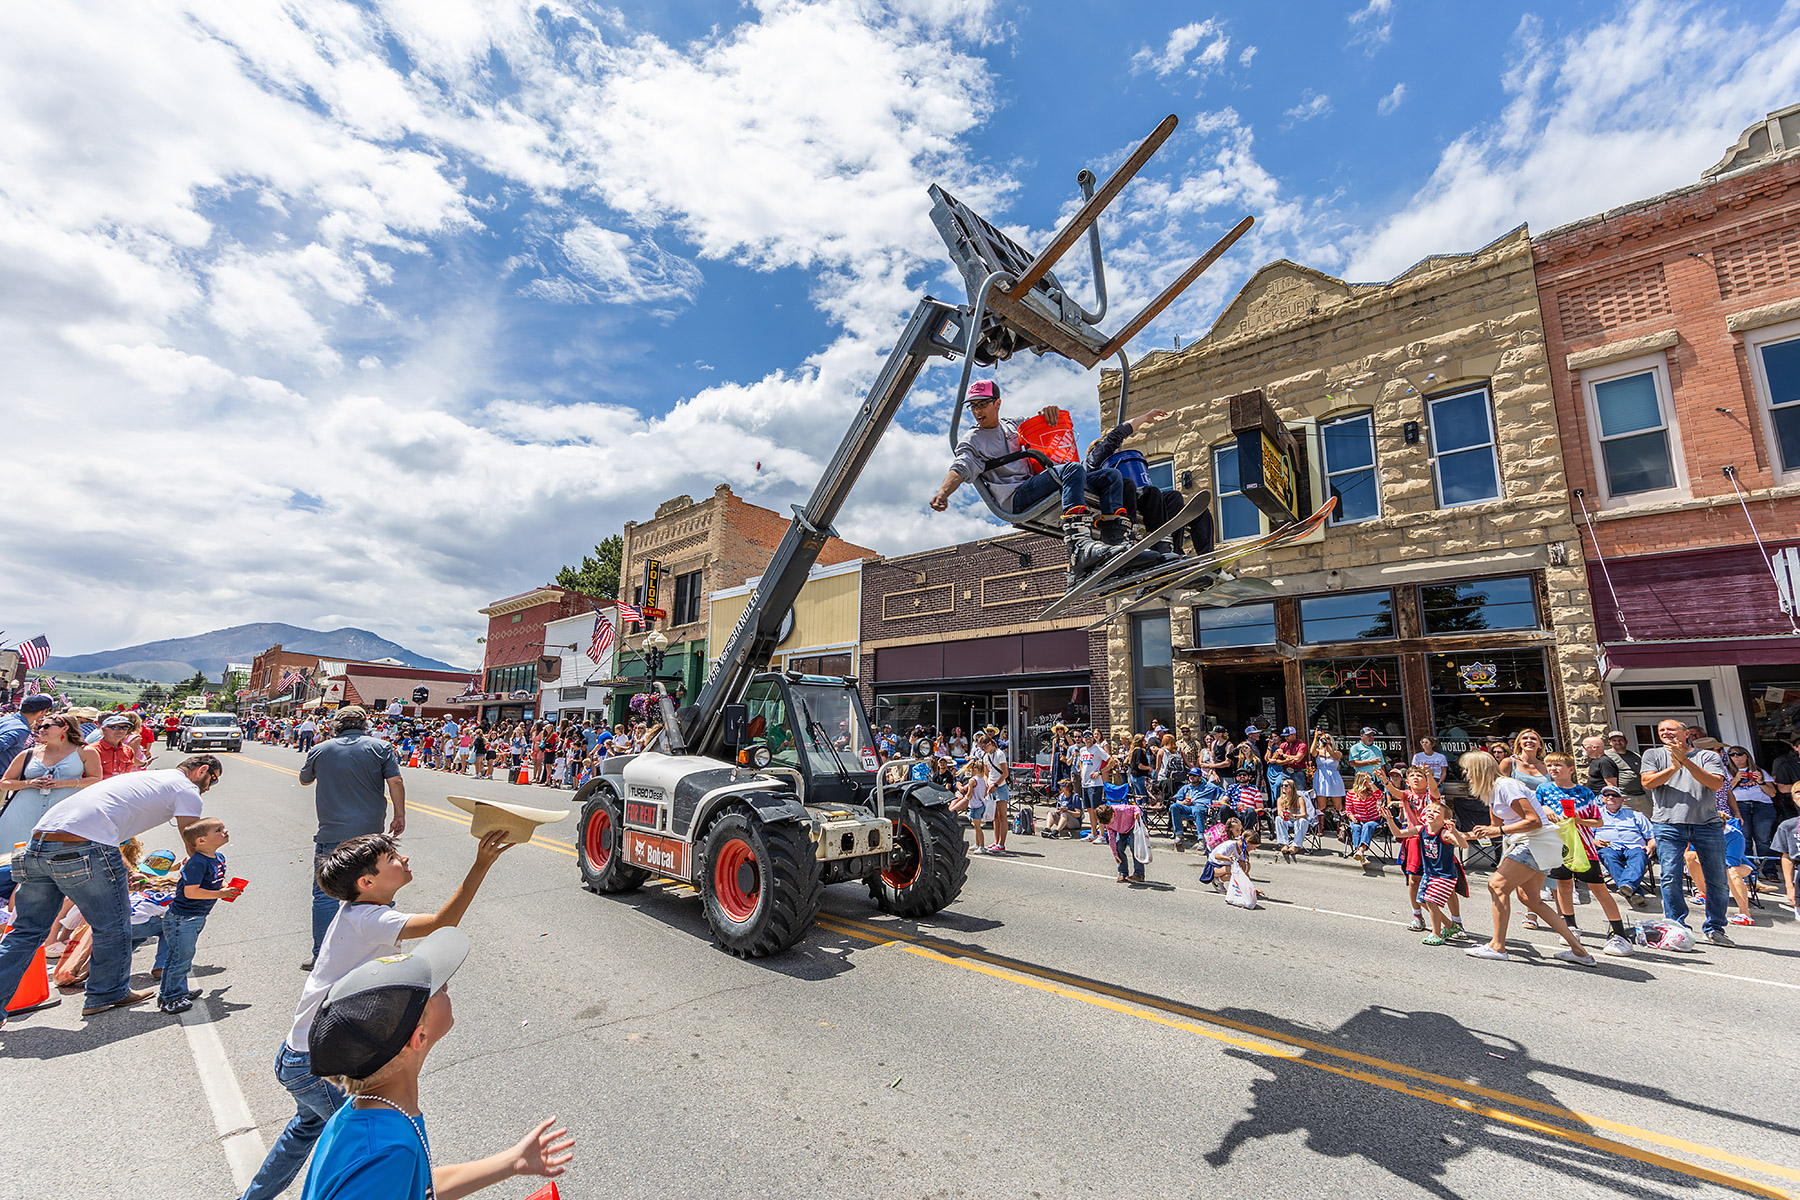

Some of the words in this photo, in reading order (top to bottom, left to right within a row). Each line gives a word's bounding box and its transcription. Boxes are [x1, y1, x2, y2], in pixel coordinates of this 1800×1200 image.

[1318, 668, 1387, 688] OPEN
[1472, 672, 1487, 681] 50
[1388, 741, 1402, 751] 1975
[1440, 742, 1467, 752] WORLD
[864, 758, 875, 766] 121
[631, 787, 648, 798] TURBO
[649, 789, 664, 800] Diesel
[626, 803, 639, 822] FOR
[640, 804, 656, 825] RENT
[647, 844, 675, 870] Bobcat
